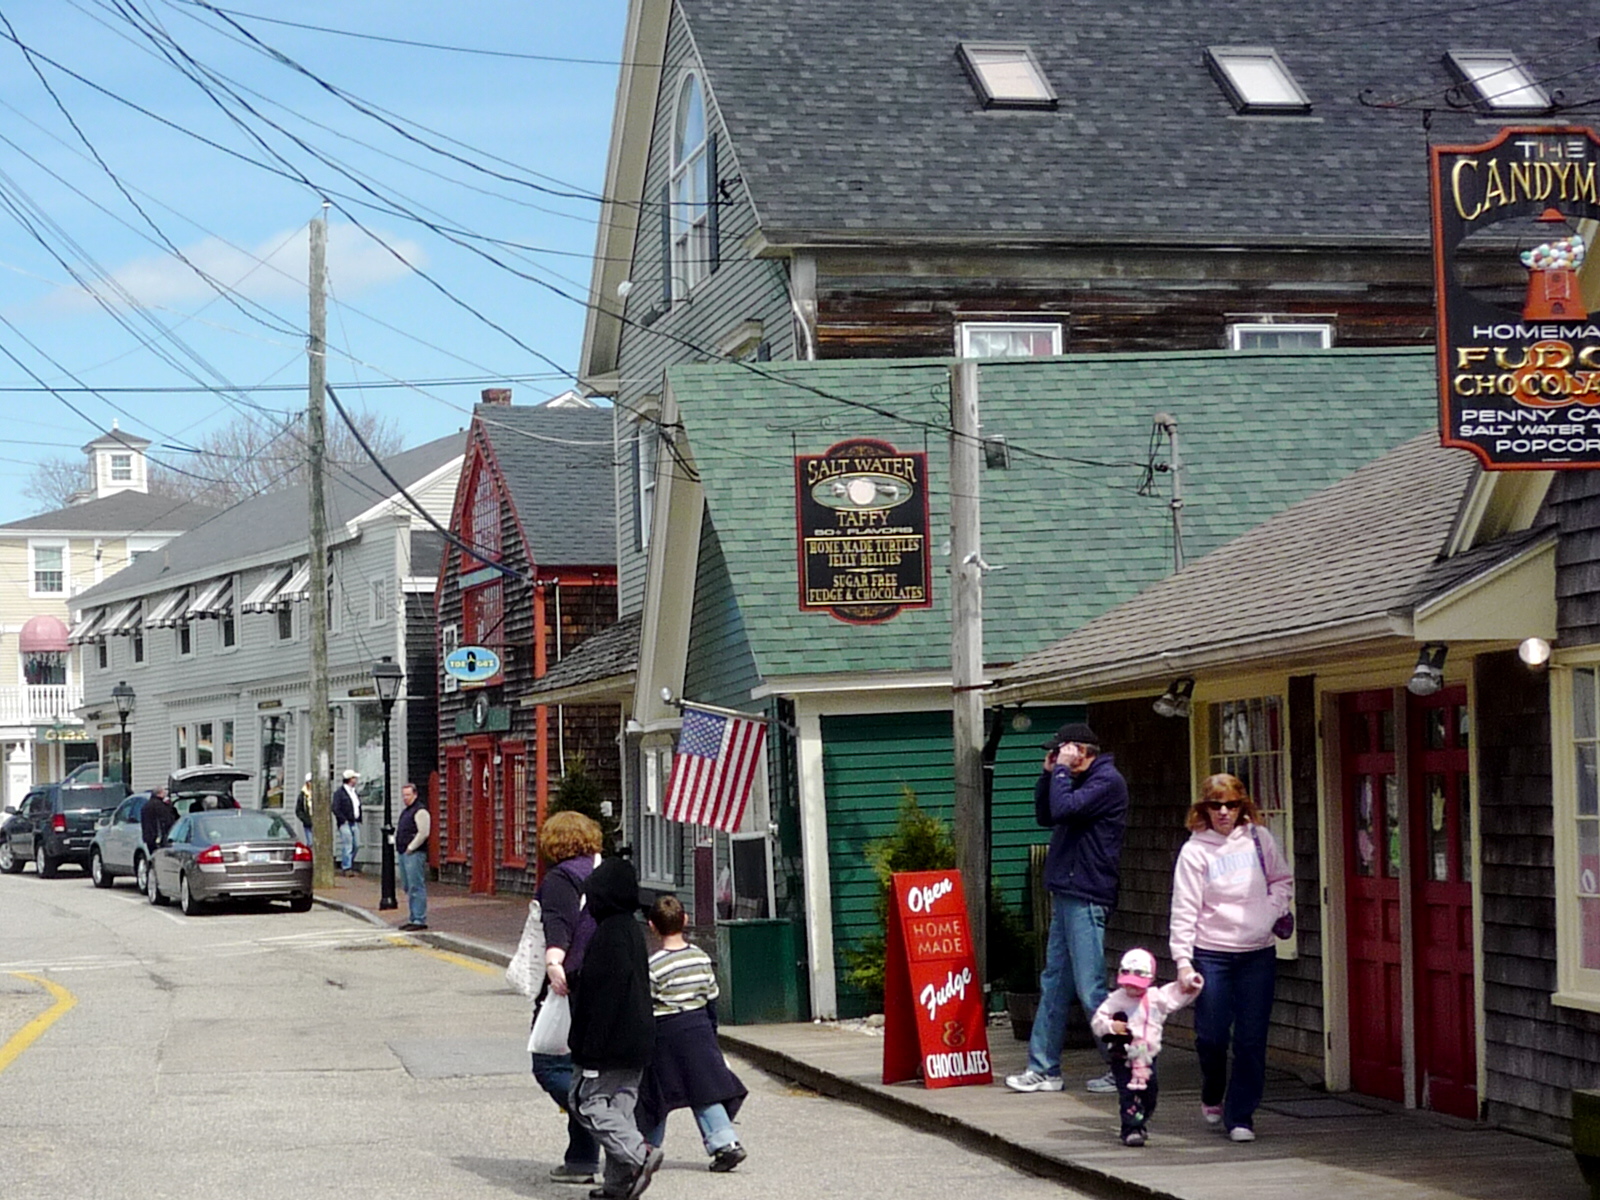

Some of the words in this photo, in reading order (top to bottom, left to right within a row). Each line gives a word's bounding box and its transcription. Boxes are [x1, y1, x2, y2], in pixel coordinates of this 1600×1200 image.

[1514, 141, 1585, 158] THE
[1451, 157, 1600, 220] CANDYM
[1461, 409, 1556, 423] PENNY
[1460, 424, 1513, 437] SALT
[1517, 423, 1585, 436] WATER
[807, 459, 849, 485] SALT
[854, 457, 917, 482] WATER
[835, 510, 891, 527] TAFFY
[847, 526, 913, 536] FLAVORS
[809, 541, 839, 555] HOME
[842, 540, 873, 553] MADE
[875, 538, 920, 552] TURTLES
[860, 552, 902, 566] BELLIES
[832, 574, 868, 588] SUGAR
[871, 573, 898, 586] FREE
[809, 588, 843, 602] FUDGE
[845, 588, 853, 600] &
[856, 586, 923, 600] CHOCOLATES
[908, 878, 953, 913] Open
[914, 920, 962, 939] HOME
[918, 937, 963, 956] MADE
[920, 967, 972, 1021] Fudge
[942, 1020, 966, 1048] &
[926, 1049, 989, 1080] CHOCOLATES
